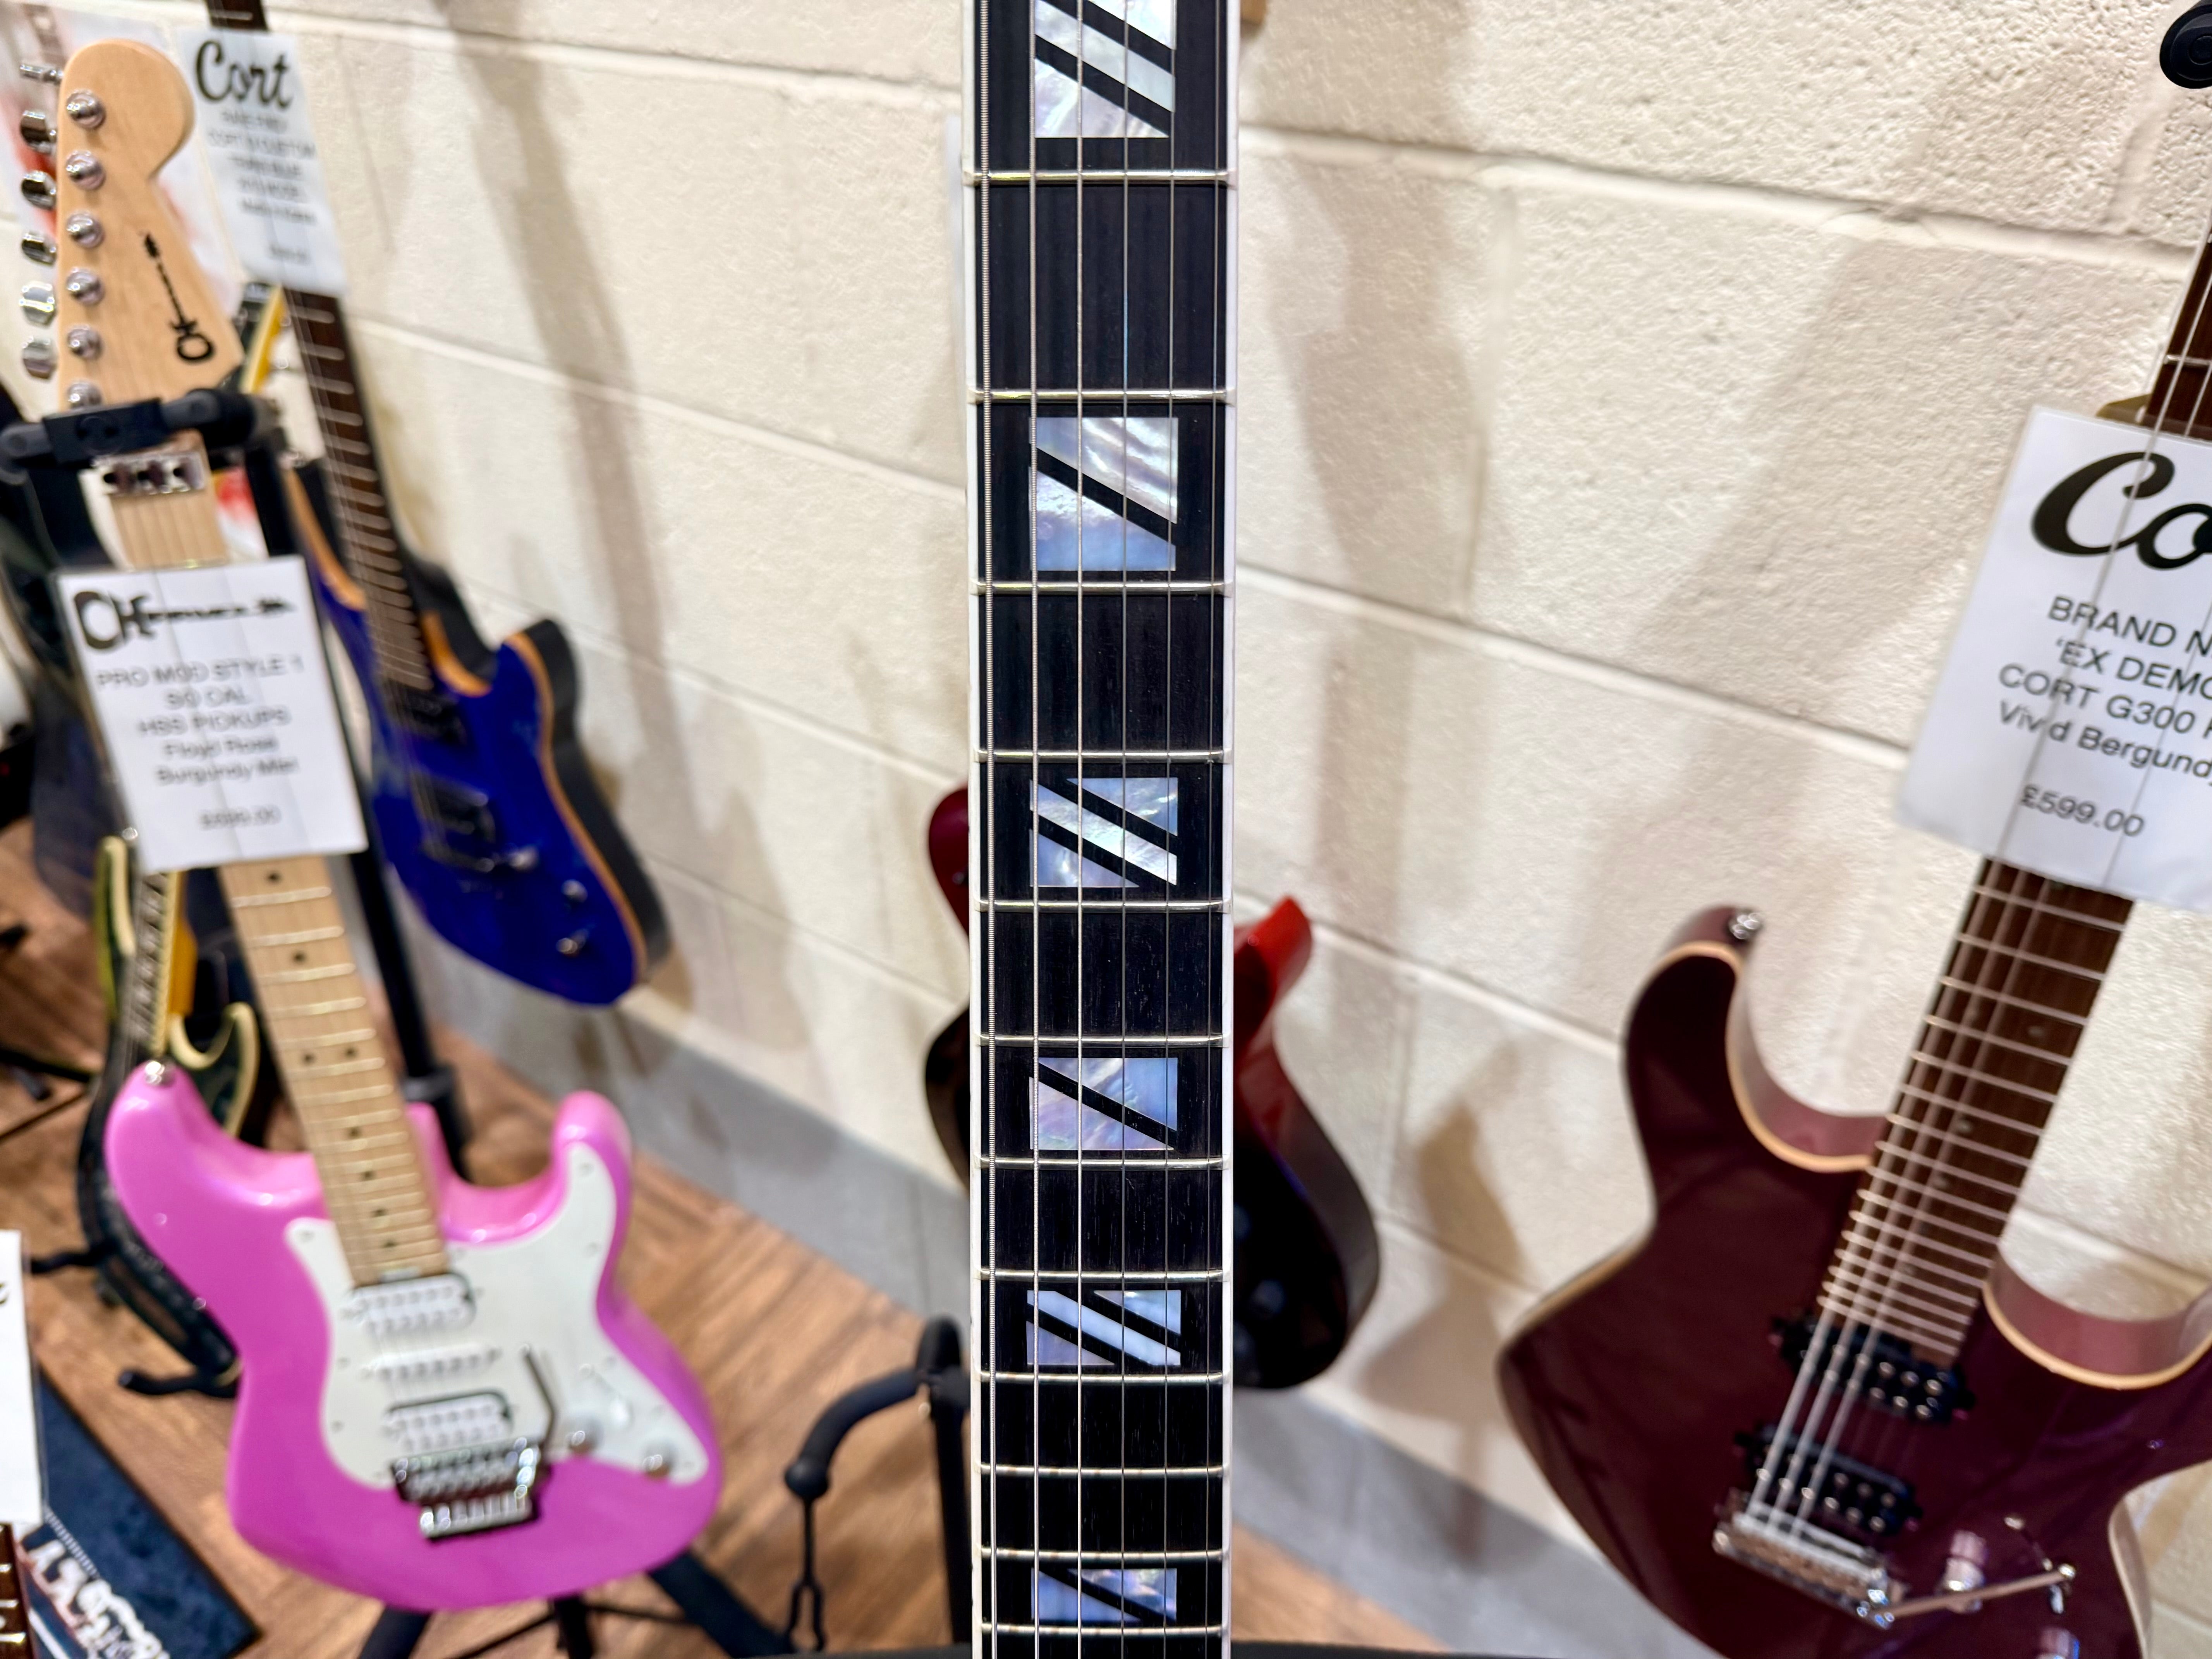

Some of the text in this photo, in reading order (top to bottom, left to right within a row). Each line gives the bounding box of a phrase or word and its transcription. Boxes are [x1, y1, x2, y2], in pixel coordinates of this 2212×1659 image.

[196, 39, 294, 109] Cort
[2049, 596, 2176, 647] BRAND
[97, 666, 149, 687] PRO
[154, 661, 210, 684] MOD
[212, 654, 287, 680] STYLE
[192, 704, 292, 732] PICKUPS
[1999, 663, 2100, 709] CORT
[2106, 694, 2195, 734] G300
[2000, 699, 2212, 787] Vivd Bergund
[2021, 783, 2145, 837] £599.00
